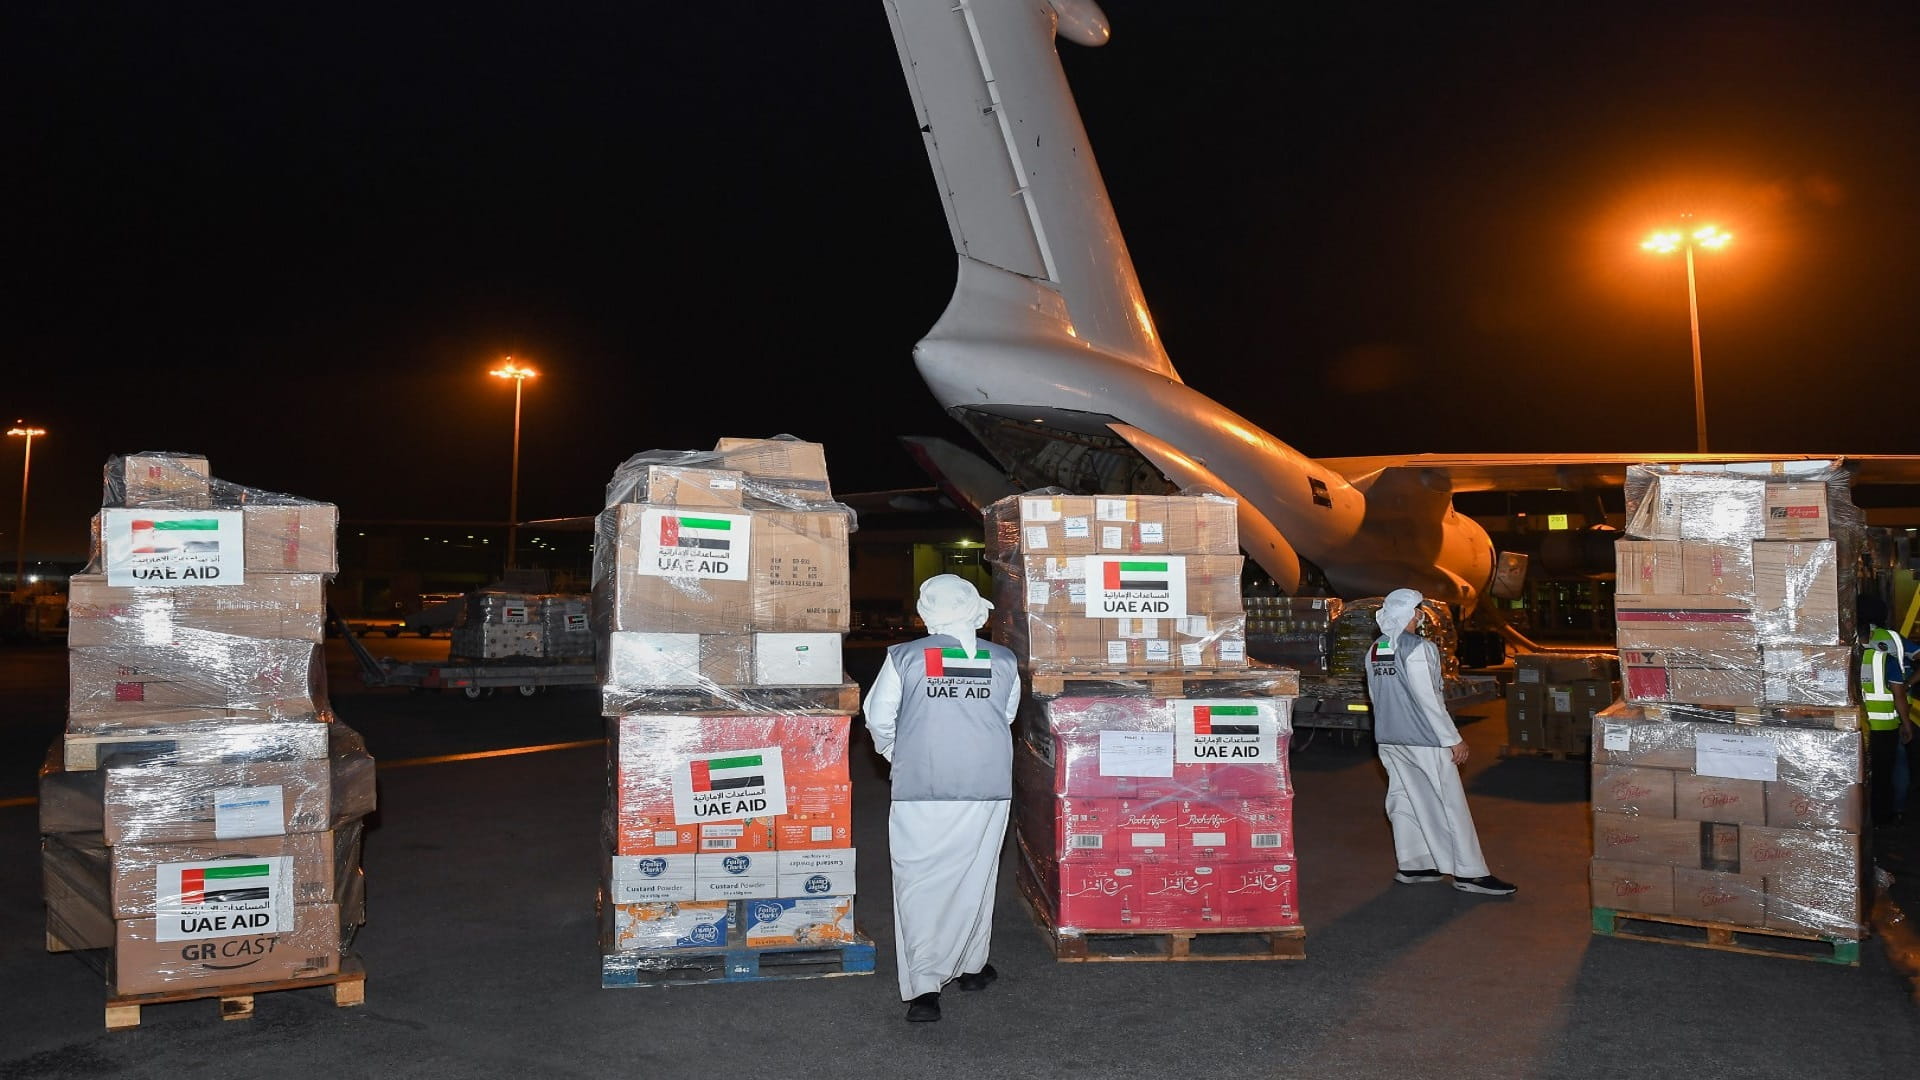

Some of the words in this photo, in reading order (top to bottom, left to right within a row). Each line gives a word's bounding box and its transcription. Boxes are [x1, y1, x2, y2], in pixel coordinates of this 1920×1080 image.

[658, 558, 694, 571] UAE
[698, 561, 729, 573] AID
[132, 566, 177, 579] UAE
[182, 566, 219, 579] AID
[1104, 601, 1137, 612] UAE
[1141, 601, 1169, 612] AID
[926, 687, 958, 698] UAE
[965, 687, 991, 699] AID
[1194, 746, 1228, 758] UAE
[1231, 746, 1260, 758] AID
[693, 792, 724, 802] الإماراتية
[725, 789, 766, 798] المساعدات
[694, 802, 731, 816] UAE
[736, 799, 767, 813] AID
[181, 917, 227, 932] UAE
[231, 913, 270, 929] AID
[182, 943, 216, 960] GR
[222, 935, 280, 957] CAST
